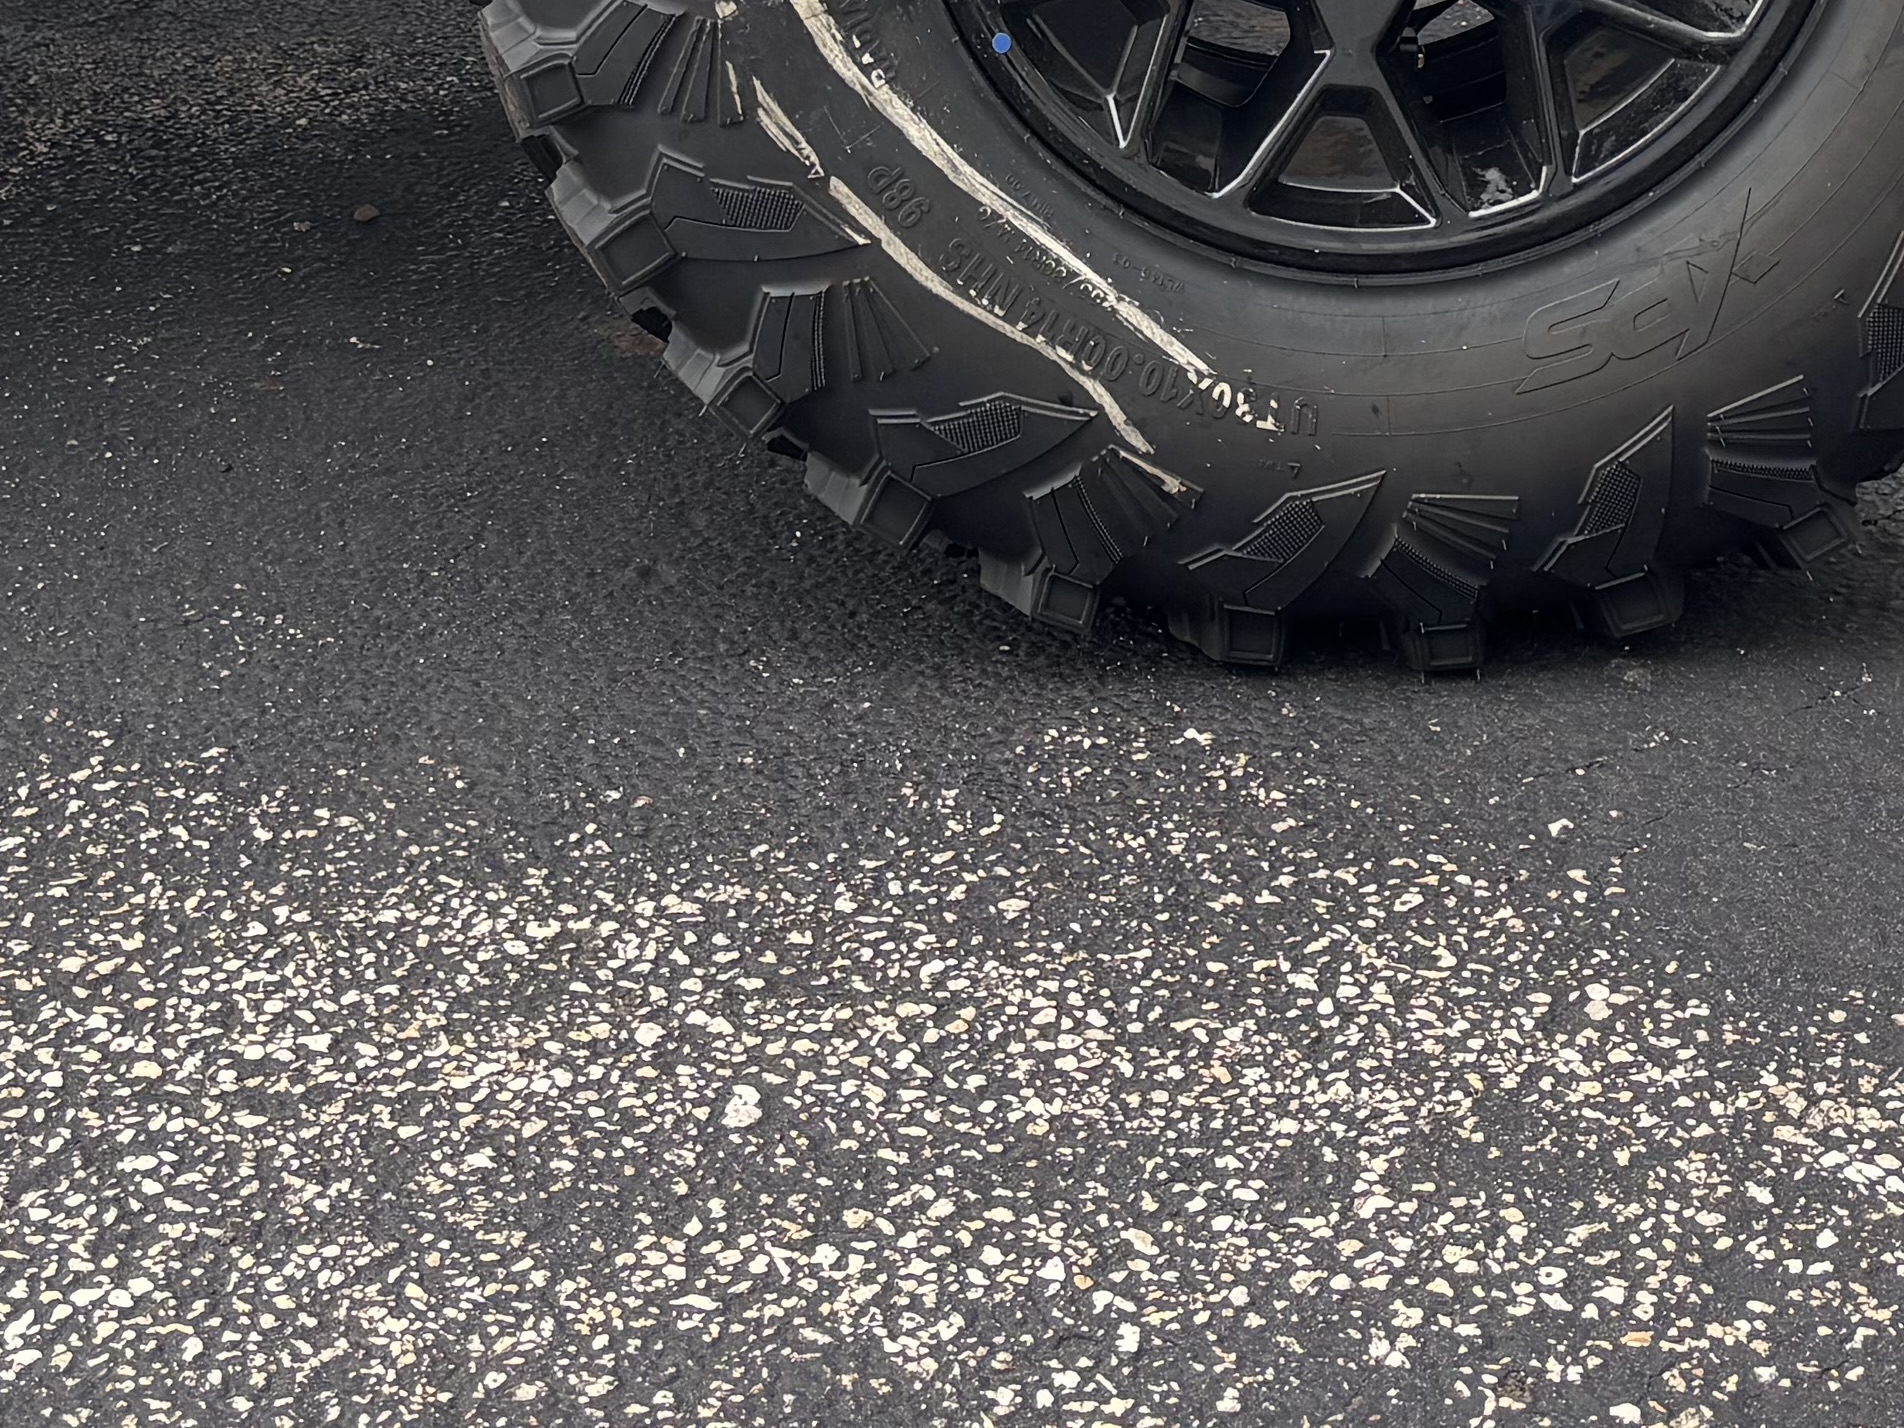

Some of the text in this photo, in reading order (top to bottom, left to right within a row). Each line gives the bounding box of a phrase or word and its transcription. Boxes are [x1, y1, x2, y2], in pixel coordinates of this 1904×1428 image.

[865, 163, 932, 228] 98P
[938, 236, 1026, 319] NHS
[1514, 187, 1781, 395] XPS
